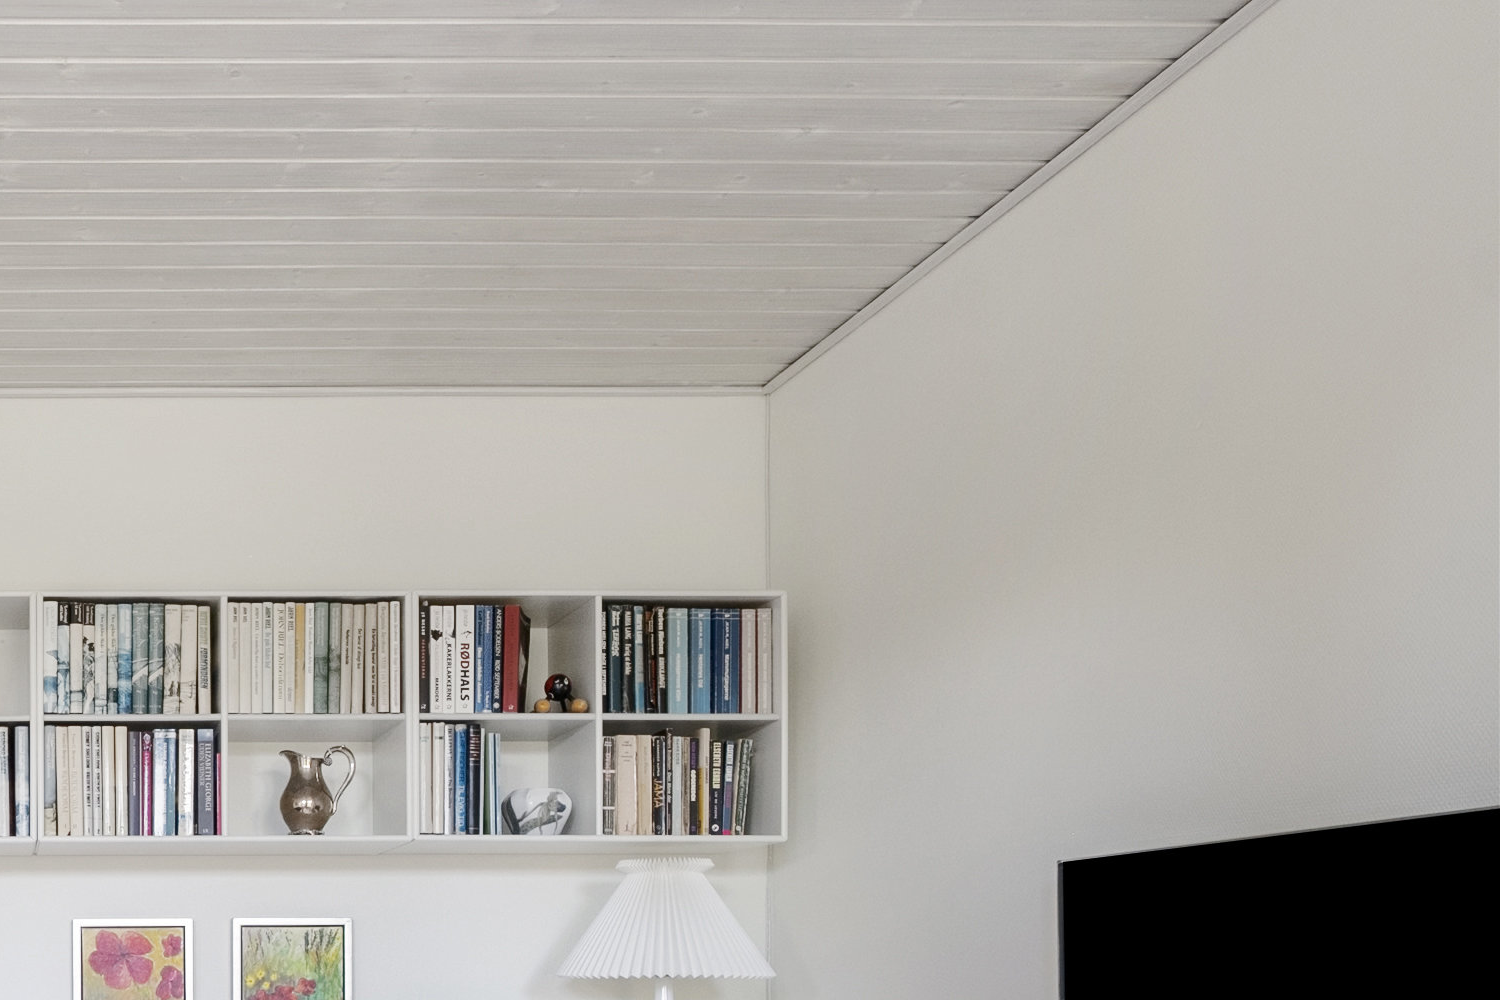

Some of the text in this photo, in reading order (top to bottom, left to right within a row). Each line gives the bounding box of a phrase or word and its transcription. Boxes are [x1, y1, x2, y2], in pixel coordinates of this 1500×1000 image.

[200, 647, 208, 689] FORMYNDEREN
[460, 643, 470, 701] RØDHALS
[713, 742, 721, 767] ELSEBETH
[653, 778, 664, 808] JAMA
